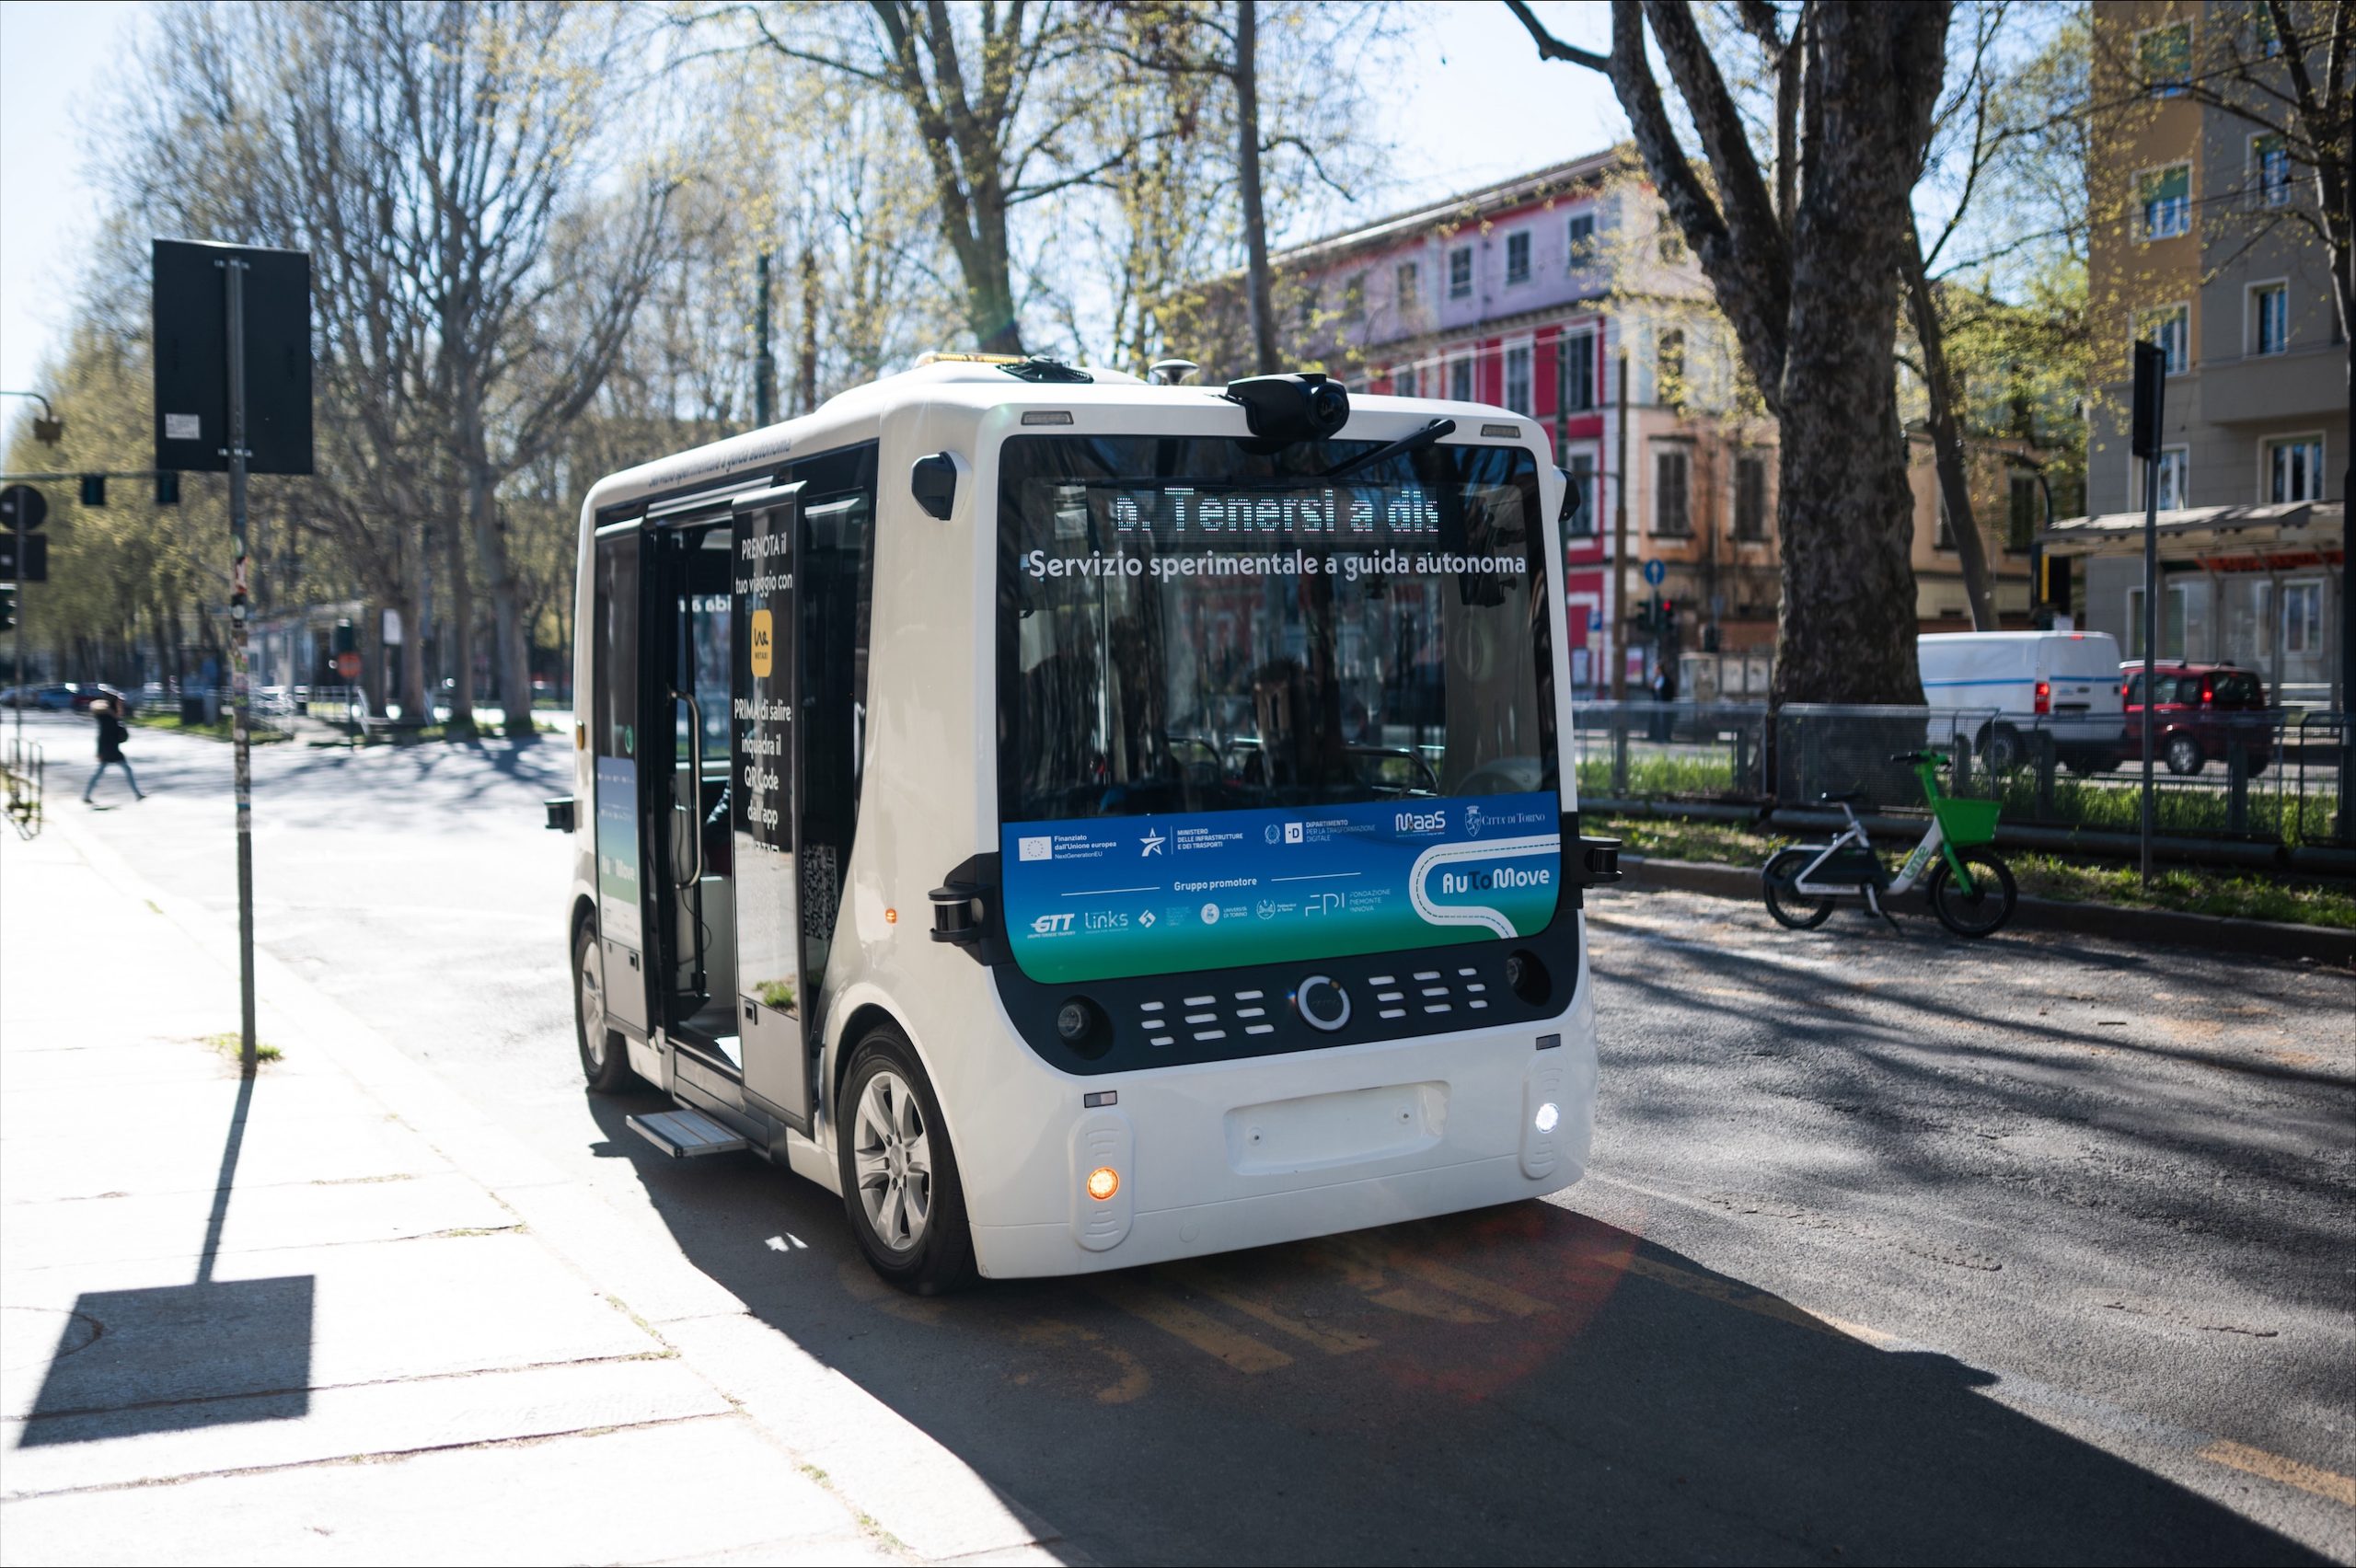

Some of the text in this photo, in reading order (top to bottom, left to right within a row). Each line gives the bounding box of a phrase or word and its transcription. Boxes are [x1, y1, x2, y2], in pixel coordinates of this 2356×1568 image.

[1164, 487, 1334, 532] Tenersi
[1349, 499, 1373, 532] a
[742, 531, 787, 560] PRENOTA il
[1029, 548, 1527, 583] Servizio sperimentale a guida autonoma
[735, 570, 793, 598] tuo viaggio con
[734, 698, 791, 721] PRIMA di salire
[741, 732, 781, 760] inquadra il
[745, 766, 780, 790] QR Code
[747, 799, 779, 831] dall'app
[1305, 819, 1348, 828] DIPARTIMENTO
[1395, 810, 1446, 832] MaaS
[1193, 841, 1223, 849] TRASPORTI
[1195, 833, 1243, 842] INFRASTRUTTURE
[1306, 835, 1332, 843] DIGITALE
[1055, 851, 1103, 859] NextGenerationEU
[1173, 878, 1257, 892] Gruppo promotore
[1030, 913, 1075, 933] GTT
